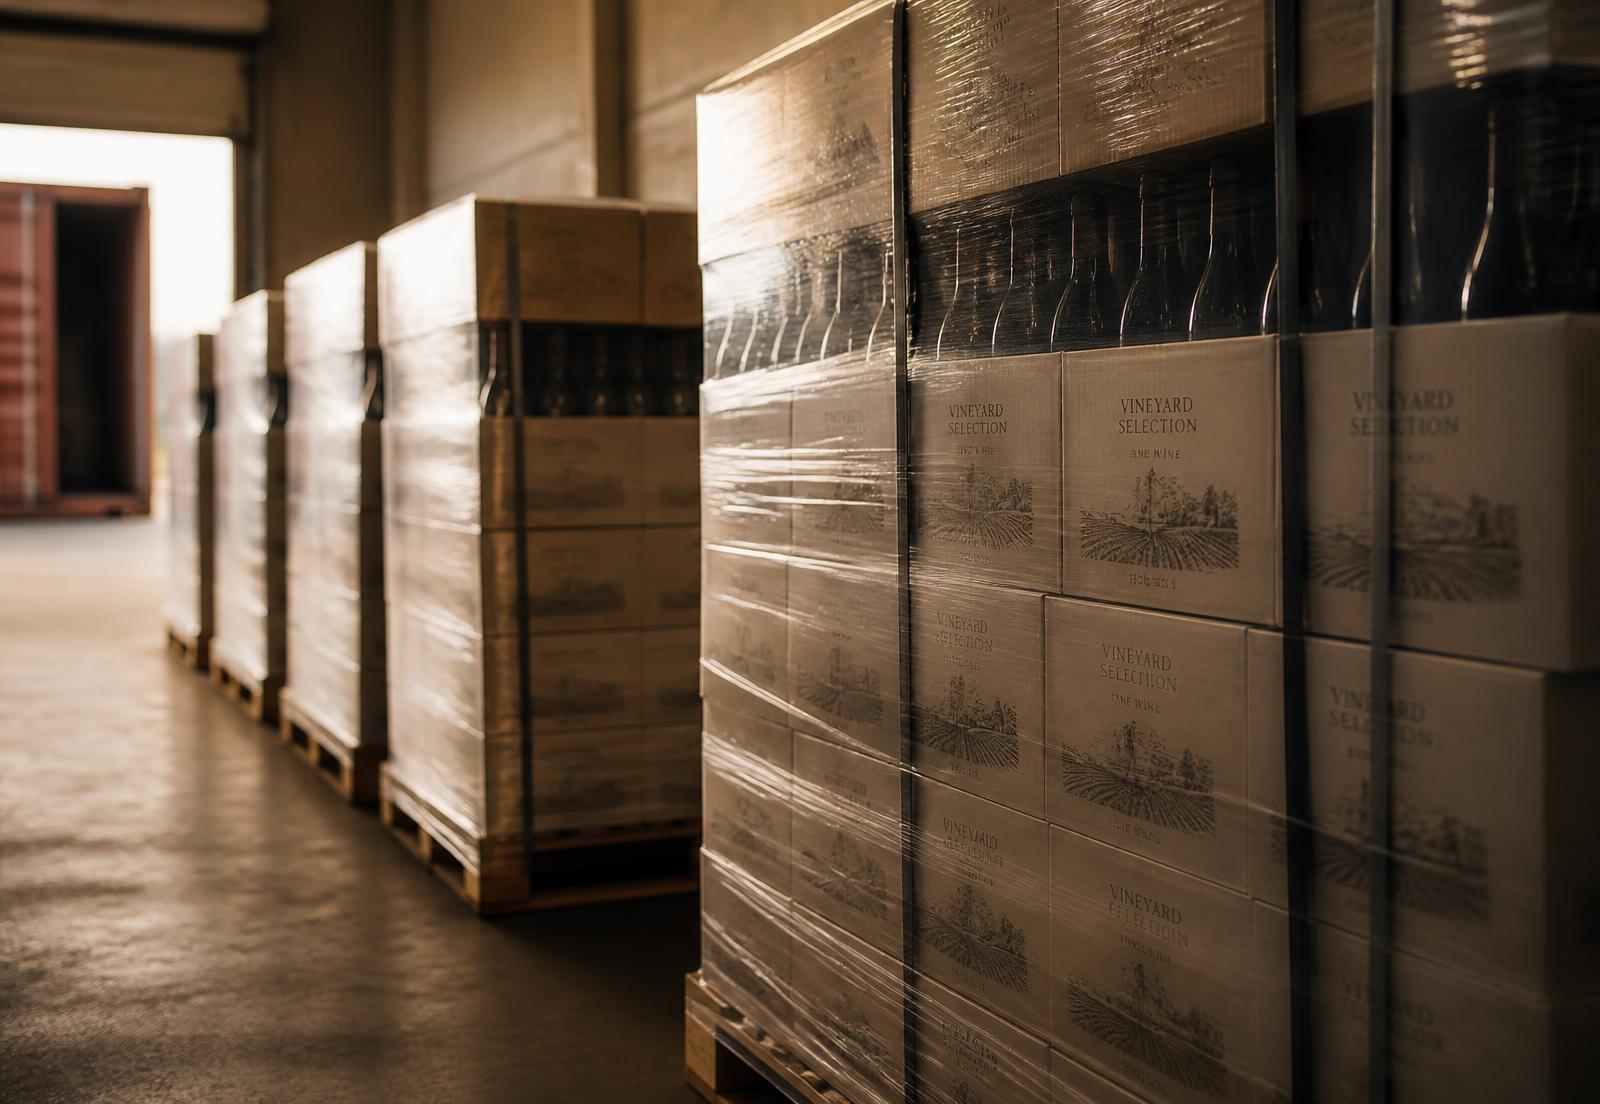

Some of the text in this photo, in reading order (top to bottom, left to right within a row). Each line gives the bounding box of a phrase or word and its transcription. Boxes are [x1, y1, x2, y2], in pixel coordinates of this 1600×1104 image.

[949, 403, 1004, 418] VINEYARD
[1120, 397, 1193, 414] VINEYARD
[1352, 390, 1455, 411] VIYARD
[948, 421, 1008, 435] SELECTION
[1118, 418, 1197, 434] SELECTION
[1350, 416, 1460, 437] SETION
[1101, 643, 1172, 671] VINEYARD
[1330, 686, 1427, 722] VINRD
[1328, 709, 1434, 747] SELON
[1110, 883, 1182, 925] VINEYARD
